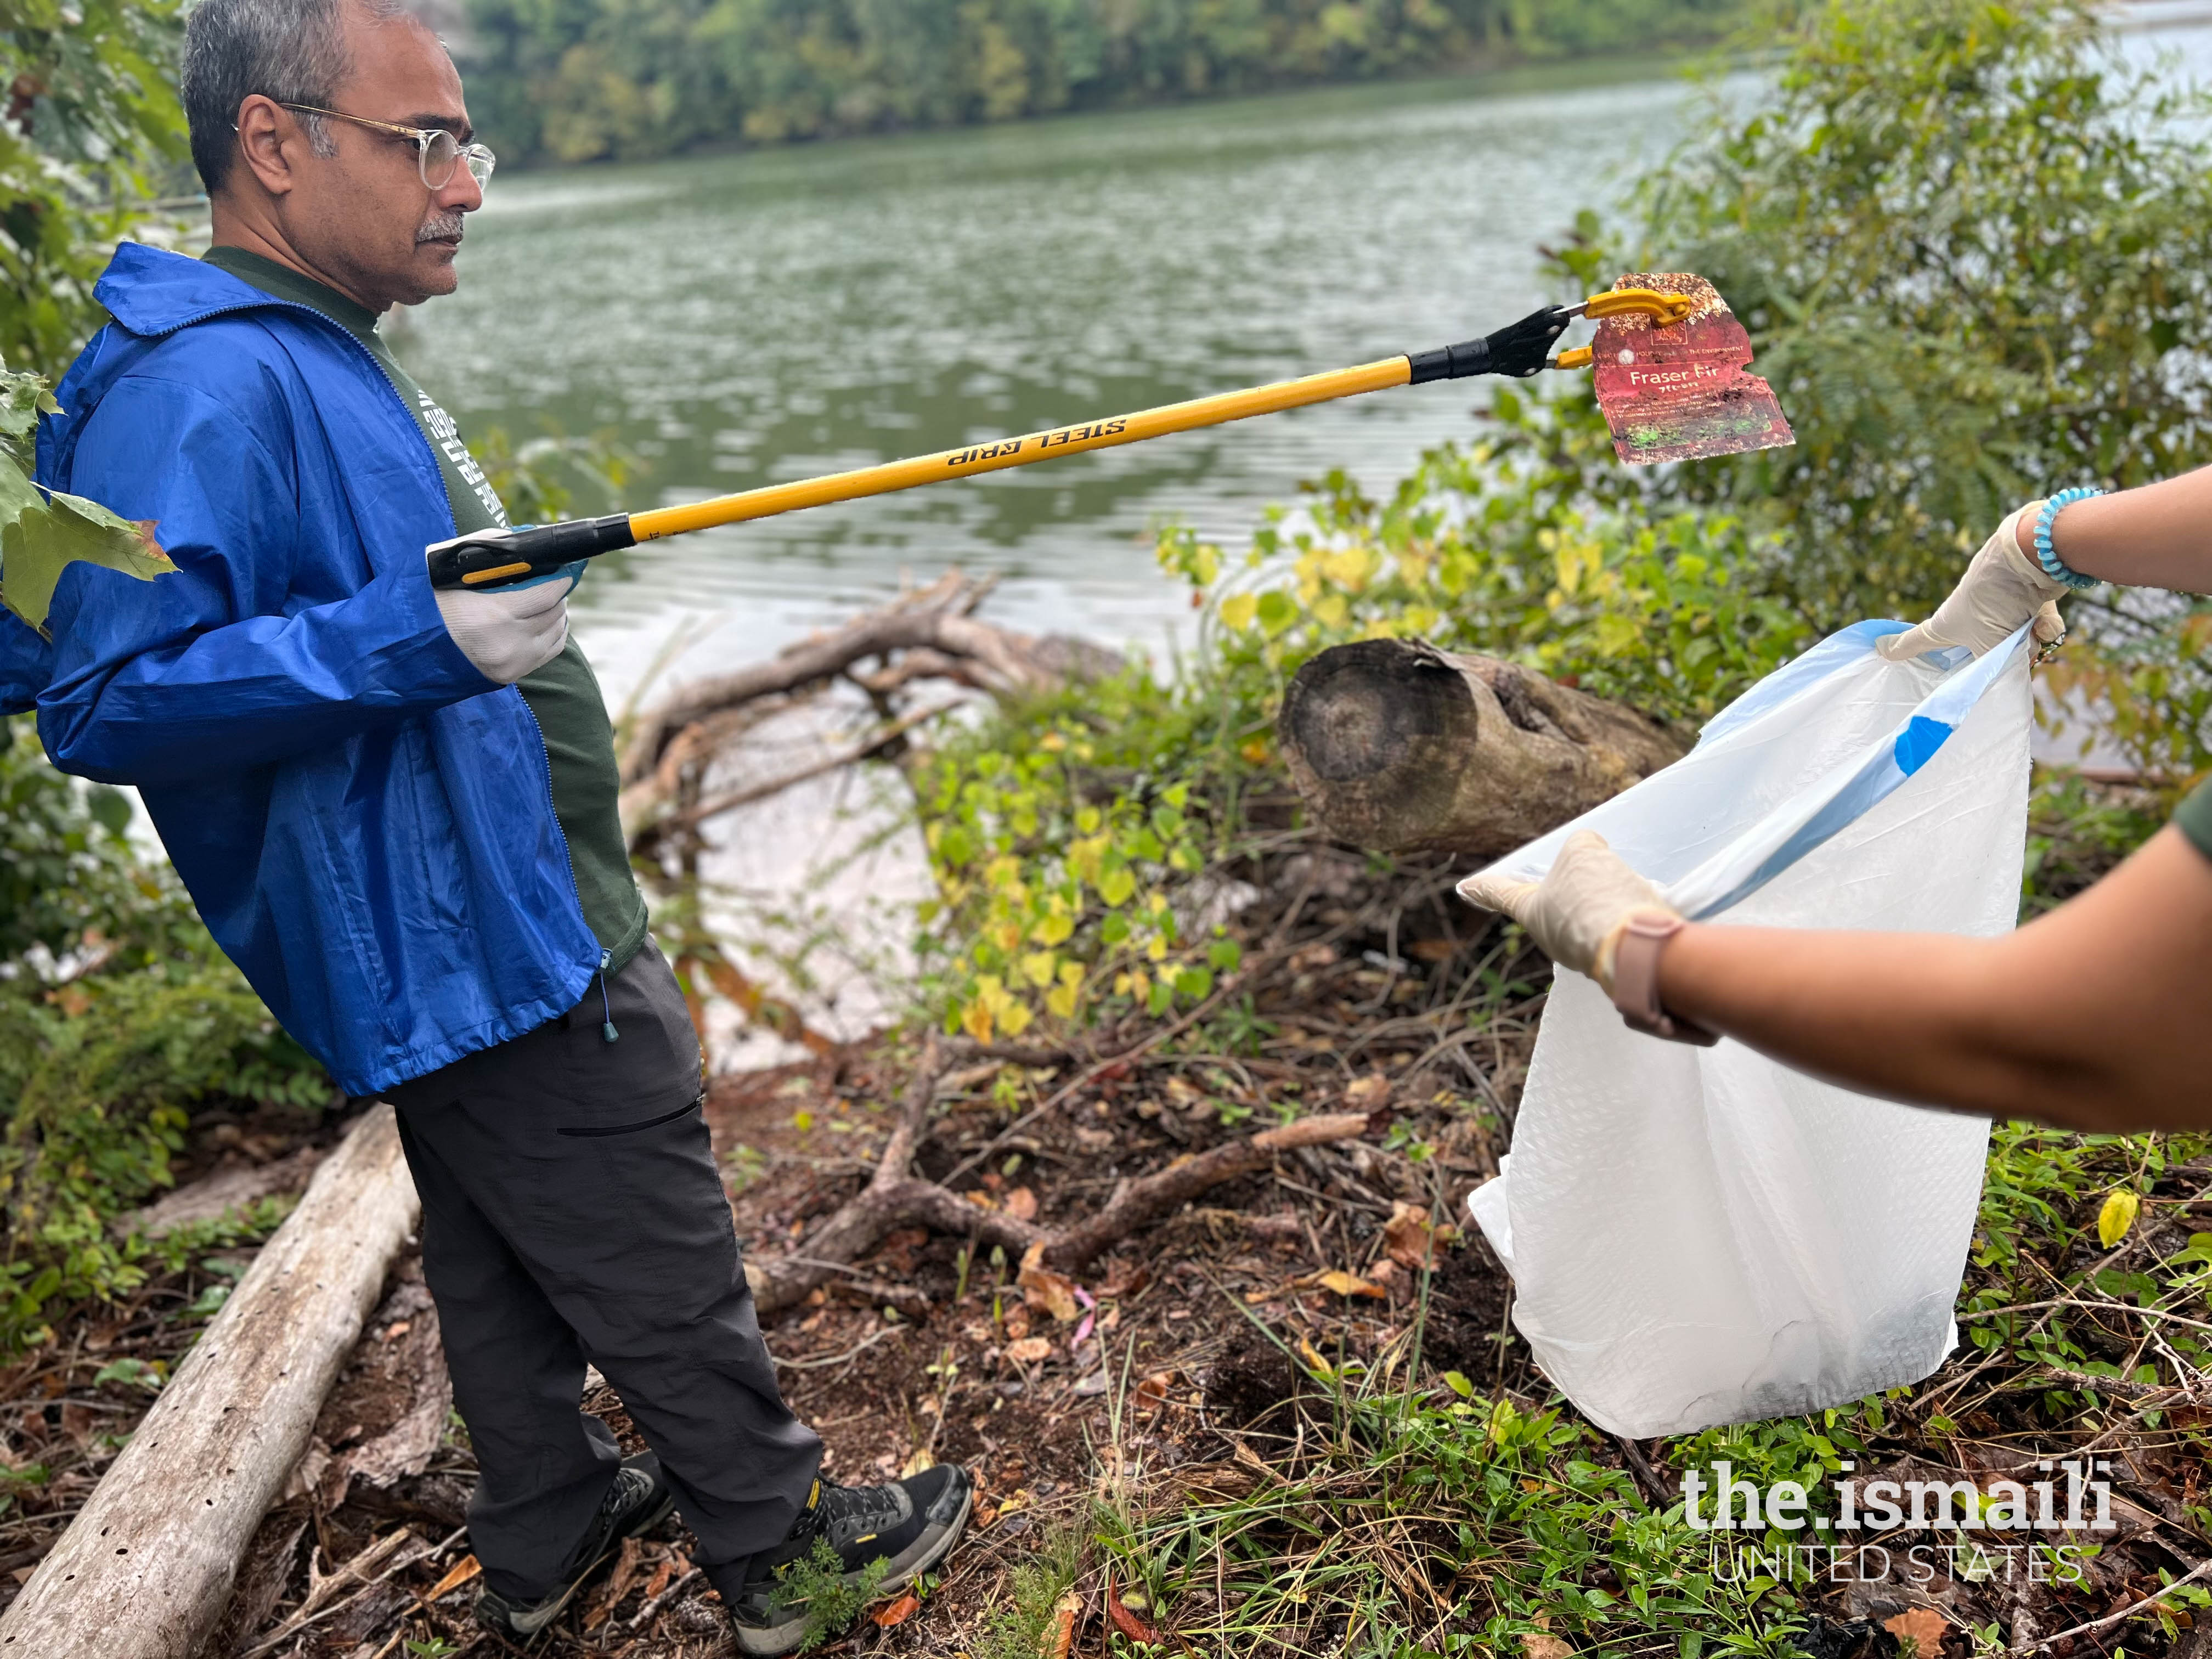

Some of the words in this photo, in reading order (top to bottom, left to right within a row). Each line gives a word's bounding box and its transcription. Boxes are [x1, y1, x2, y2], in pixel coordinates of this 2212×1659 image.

[1702, 346, 1743, 355] ENVIRONMENT
[1630, 370, 1689, 386] Fraser
[1694, 364, 1719, 379] Fir
[1030, 419, 1127, 448] STEEL
[947, 440, 1022, 466] GRIP
